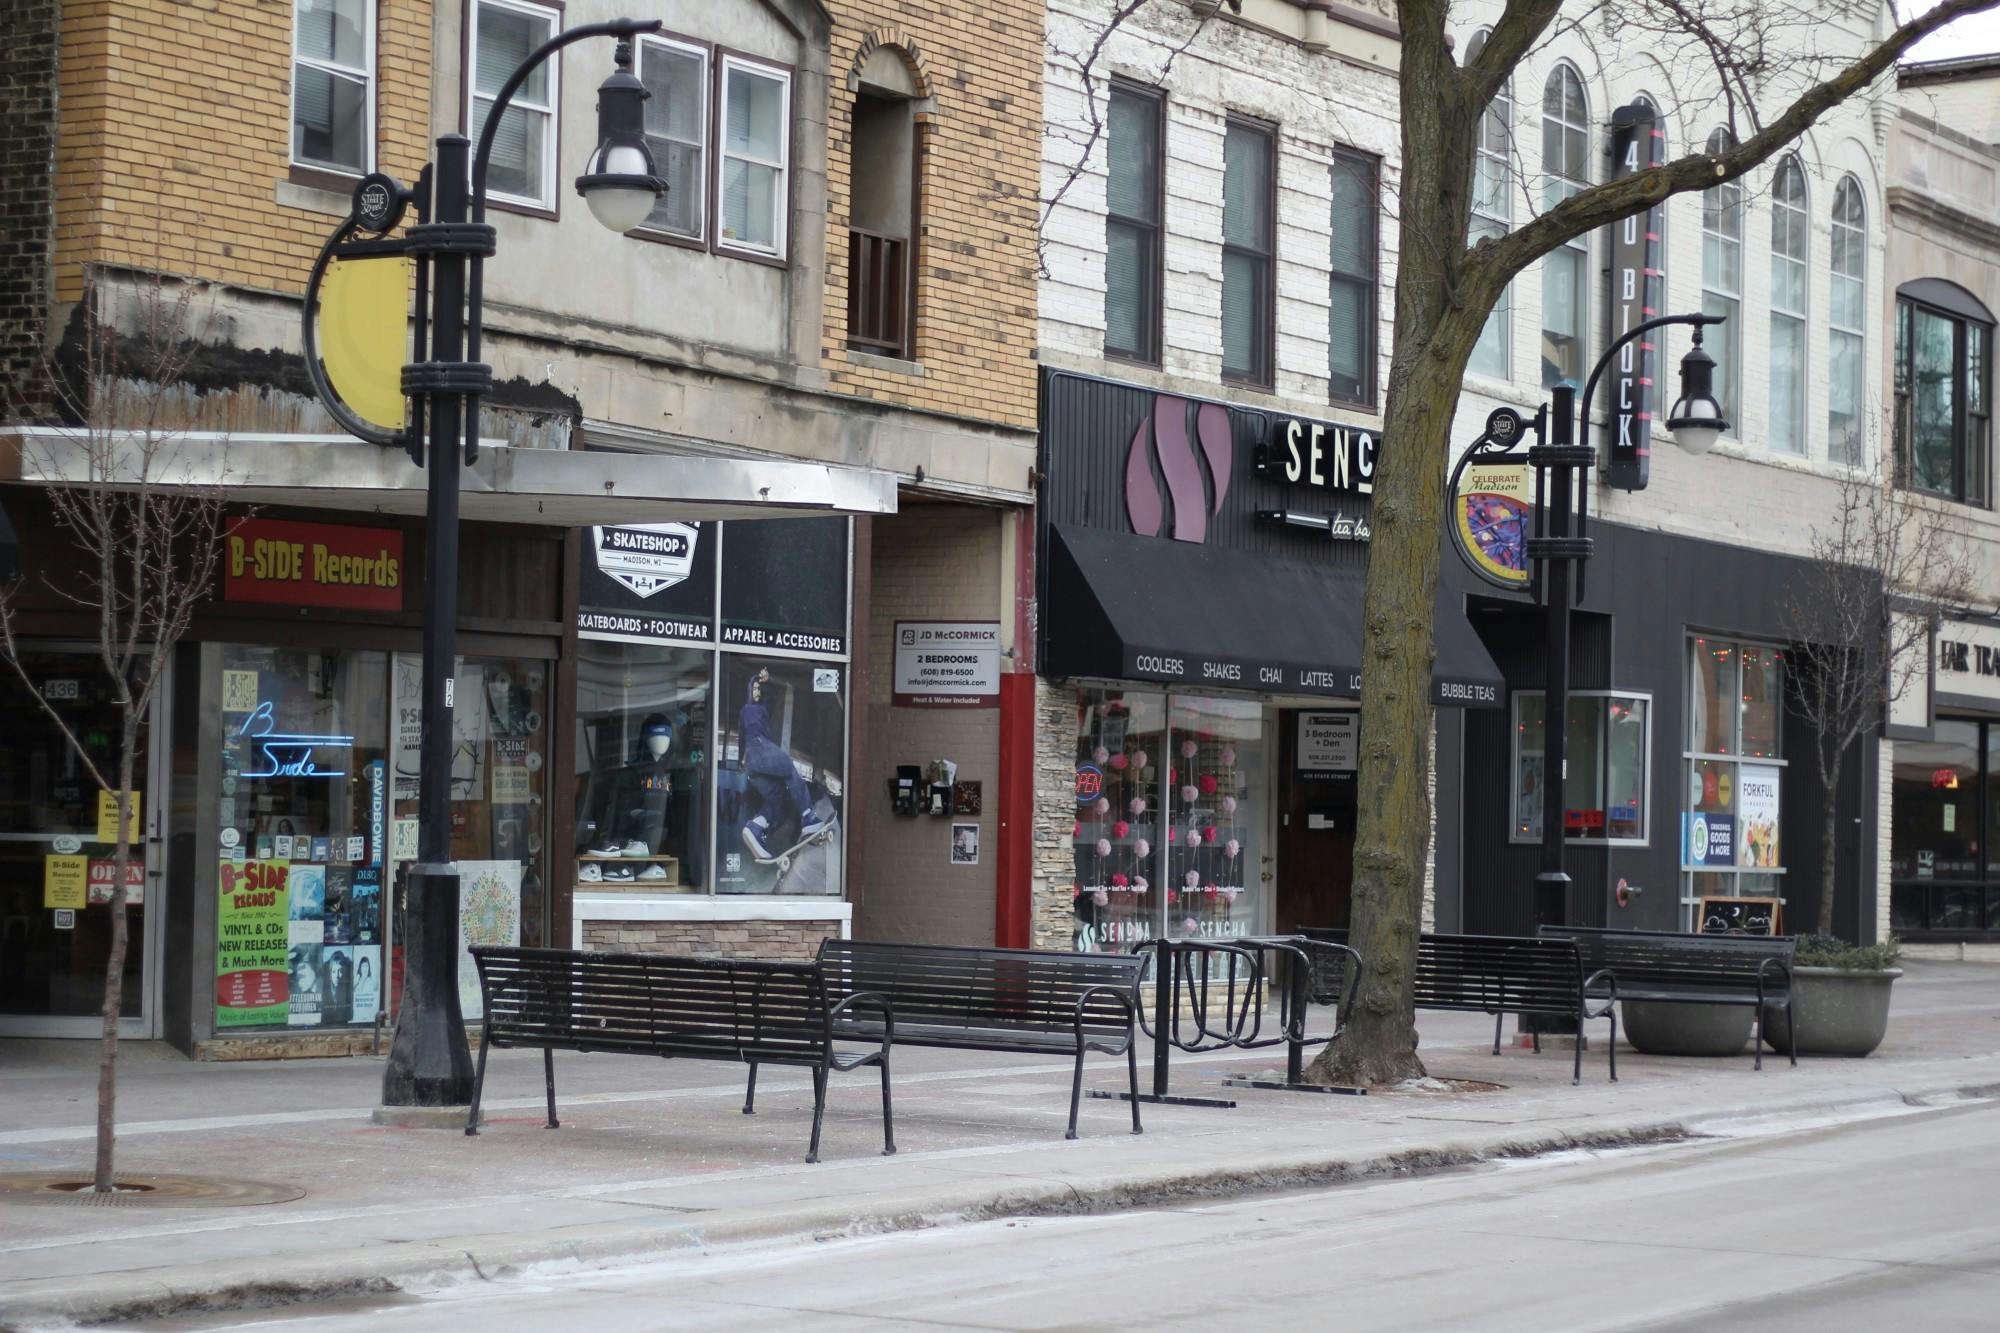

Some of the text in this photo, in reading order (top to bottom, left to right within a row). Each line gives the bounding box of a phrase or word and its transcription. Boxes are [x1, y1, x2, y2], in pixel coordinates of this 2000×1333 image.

[361, 193, 385, 204] STATE
[1624, 140, 1639, 246] 40
[1618, 268, 1636, 447] BLOCK
[1467, 481, 1518, 492] Madison
[1472, 475, 1521, 483] CELEBRATE
[1332, 512, 1355, 536] tea
[613, 531, 680, 553] SKATESHOP
[230, 535, 399, 588] B-SIDE Records
[623, 555, 662, 567] MADISON, WI
[650, 620, 708, 638] FOOTWEAR
[920, 631, 995, 640] JD McCORMICK
[724, 627, 841, 652] APPAREL ACCESSORIES
[917, 655, 978, 664] 2 BEDROOMS
[1941, 640, 1969, 673] FAIR
[920, 668, 939, 677] (608)
[1136, 655, 1184, 675] COOLERS
[1203, 661, 1241, 680] SHAKES
[1259, 666, 1282, 683] CHAI
[1300, 671, 1334, 688] LATTES
[47, 683, 77, 697] 436
[1441, 682, 1495, 701] BUBBLE TEAS
[240, 701, 274, 737] B
[1312, 729, 1352, 738] Bedroom
[1323, 739, 1340, 747] Den
[1743, 783, 1774, 798] FORKFUL
[1710, 832, 1731, 844] GOODS
[1715, 845, 1731, 856] MORE
[91, 865, 145, 881] OPN
[220, 861, 289, 895] B-SIDE
[233, 891, 276, 909] RECORDS
[224, 923, 284, 936] VINYL & CDs
[219, 938, 288, 953] NEW RELEASES
[222, 955, 285, 968] & Much More
